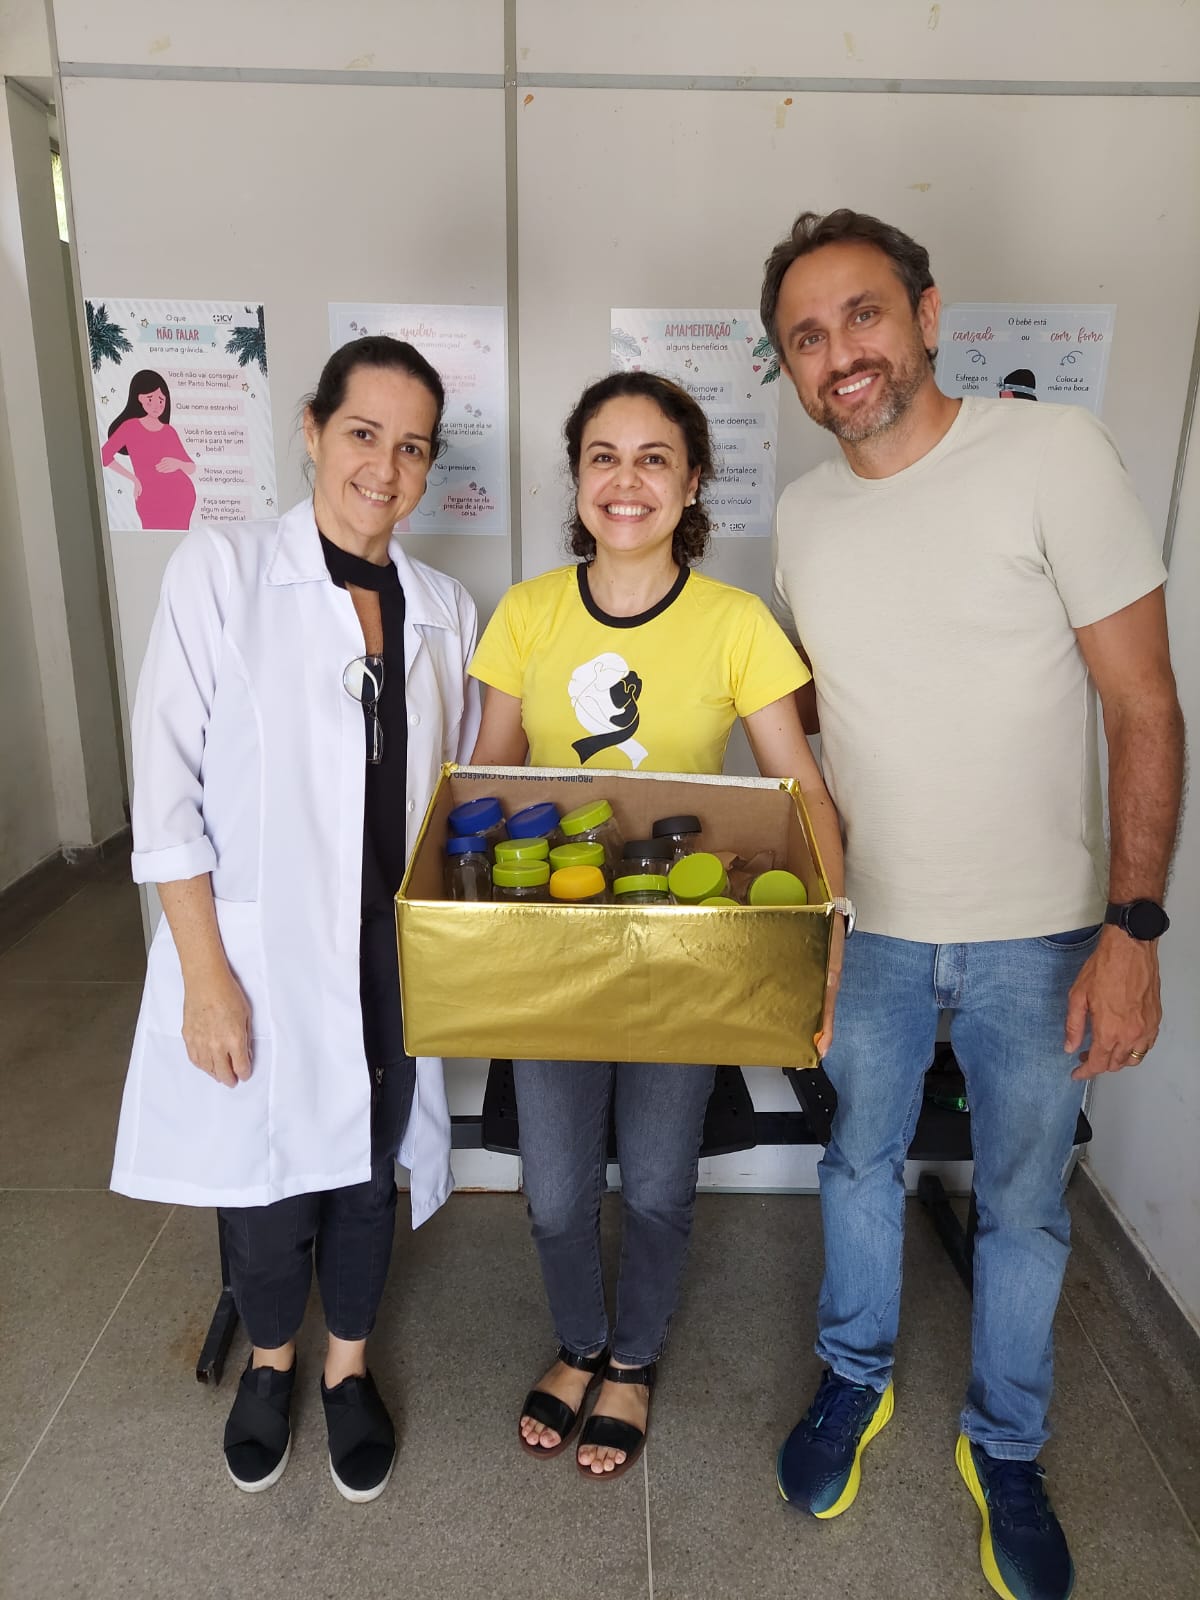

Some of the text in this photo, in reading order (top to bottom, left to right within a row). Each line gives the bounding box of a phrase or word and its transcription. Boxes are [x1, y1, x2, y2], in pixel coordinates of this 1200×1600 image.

[173, 315, 186, 323] que
[220, 314, 233, 322] ICV
[1016, 317, 1032, 325] bebê
[1033, 318, 1047, 326] está
[156, 326, 200, 341] NÃO FALAR
[665, 322, 731, 340] AMAMENTAÇÃO
[953, 326, 995, 343] cansado
[1050, 326, 1104, 344] com fome
[150, 346, 165, 354] para
[666, 342, 728, 351] alguns benefícios
[185, 371, 197, 379] não
[208, 372, 239, 381] conseguir
[955, 374, 980, 383] Esfrega
[1055, 375, 1078, 383] Coloca
[962, 382, 980, 390] olhos
[726, 417, 758, 426] doenças.
[200, 428, 212, 436] não
[726, 466, 757, 474] fortalece
[203, 498, 217, 506] Faça
[728, 497, 752, 505] vínculo
